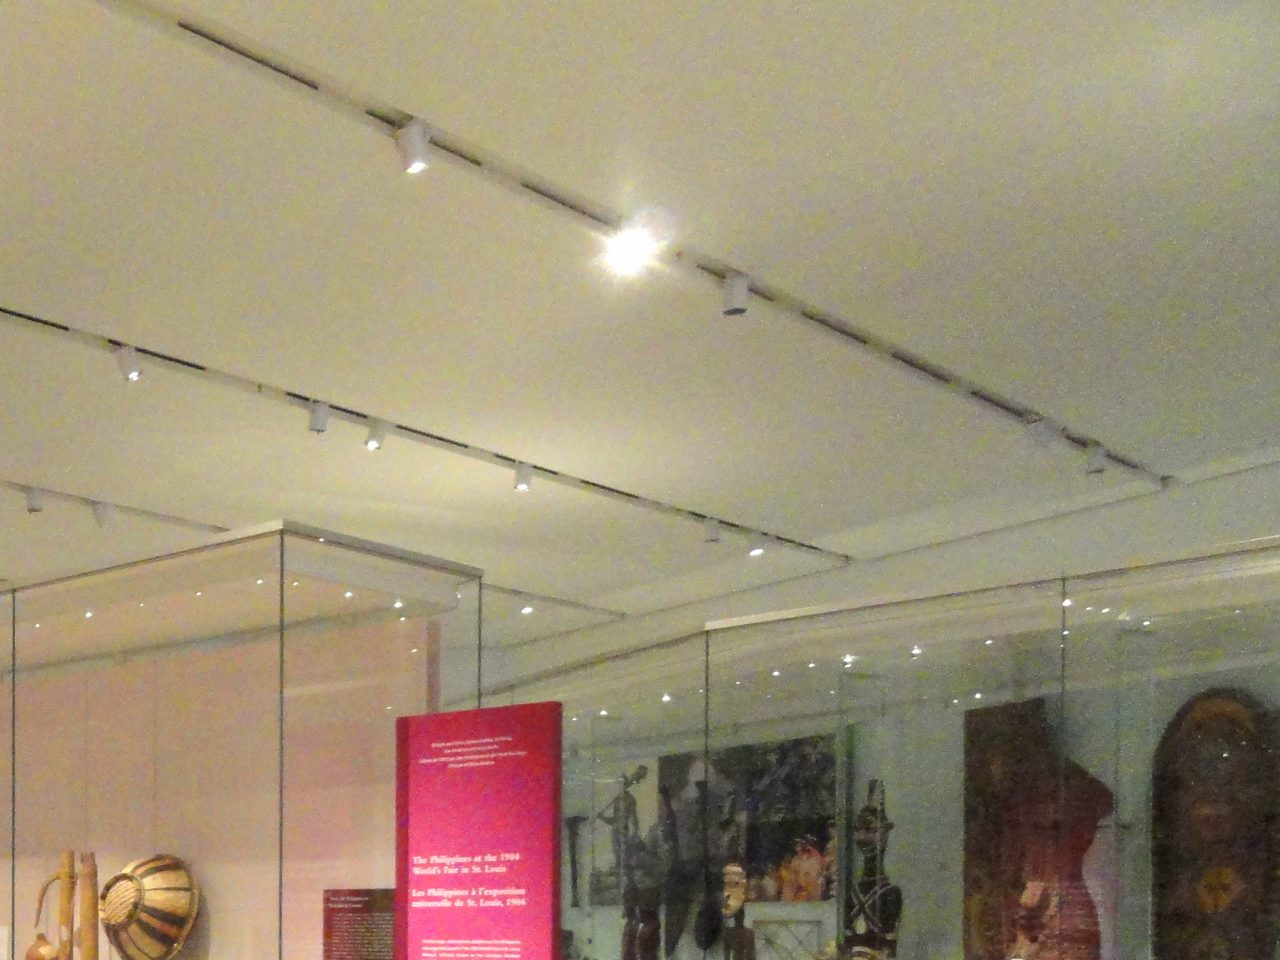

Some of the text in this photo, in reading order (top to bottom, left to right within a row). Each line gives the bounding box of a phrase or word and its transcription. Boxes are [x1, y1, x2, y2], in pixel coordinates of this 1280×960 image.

[413, 856, 427, 864] The
[429, 855, 471, 865] Philippines
[484, 854, 497, 862] the
[484, 864, 508, 873] Louis
[427, 888, 469, 898] Philippines
